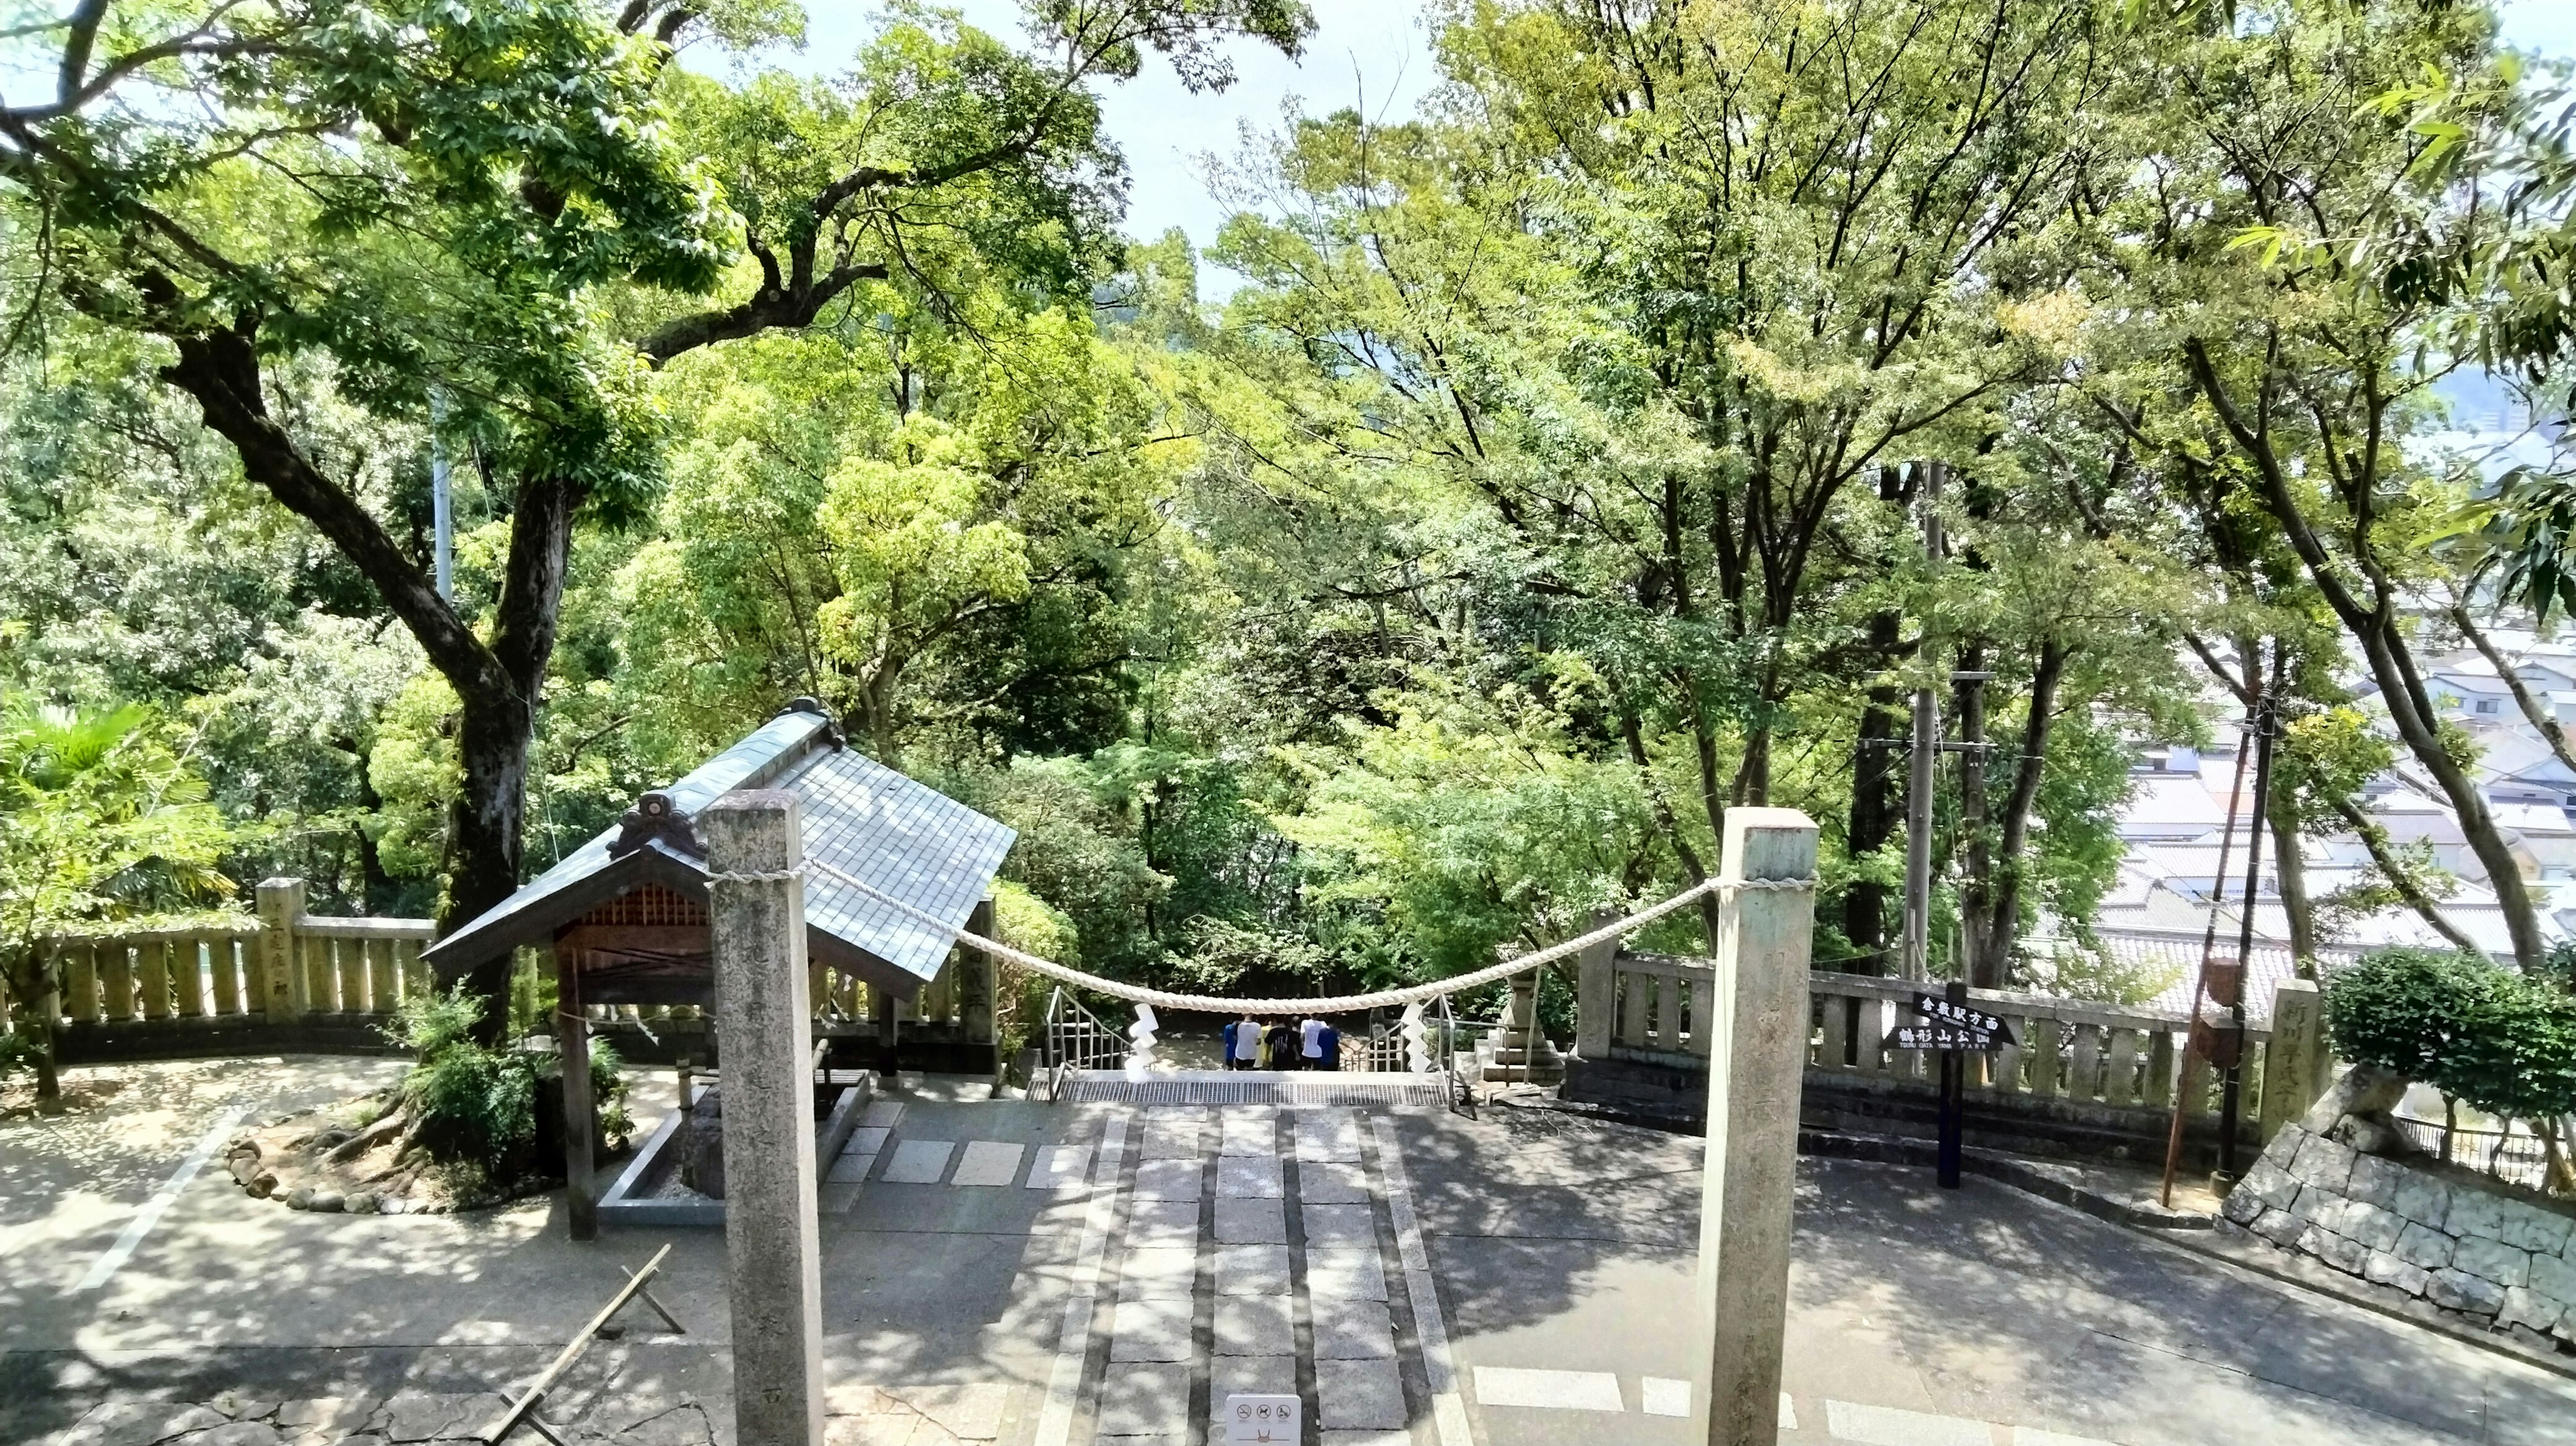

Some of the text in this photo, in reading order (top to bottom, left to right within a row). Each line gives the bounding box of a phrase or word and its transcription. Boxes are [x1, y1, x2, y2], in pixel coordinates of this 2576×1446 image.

[1922, 997, 1999, 1030] 倉敷駅方面
[1899, 1027, 1990, 1044] 鶴形山公園
